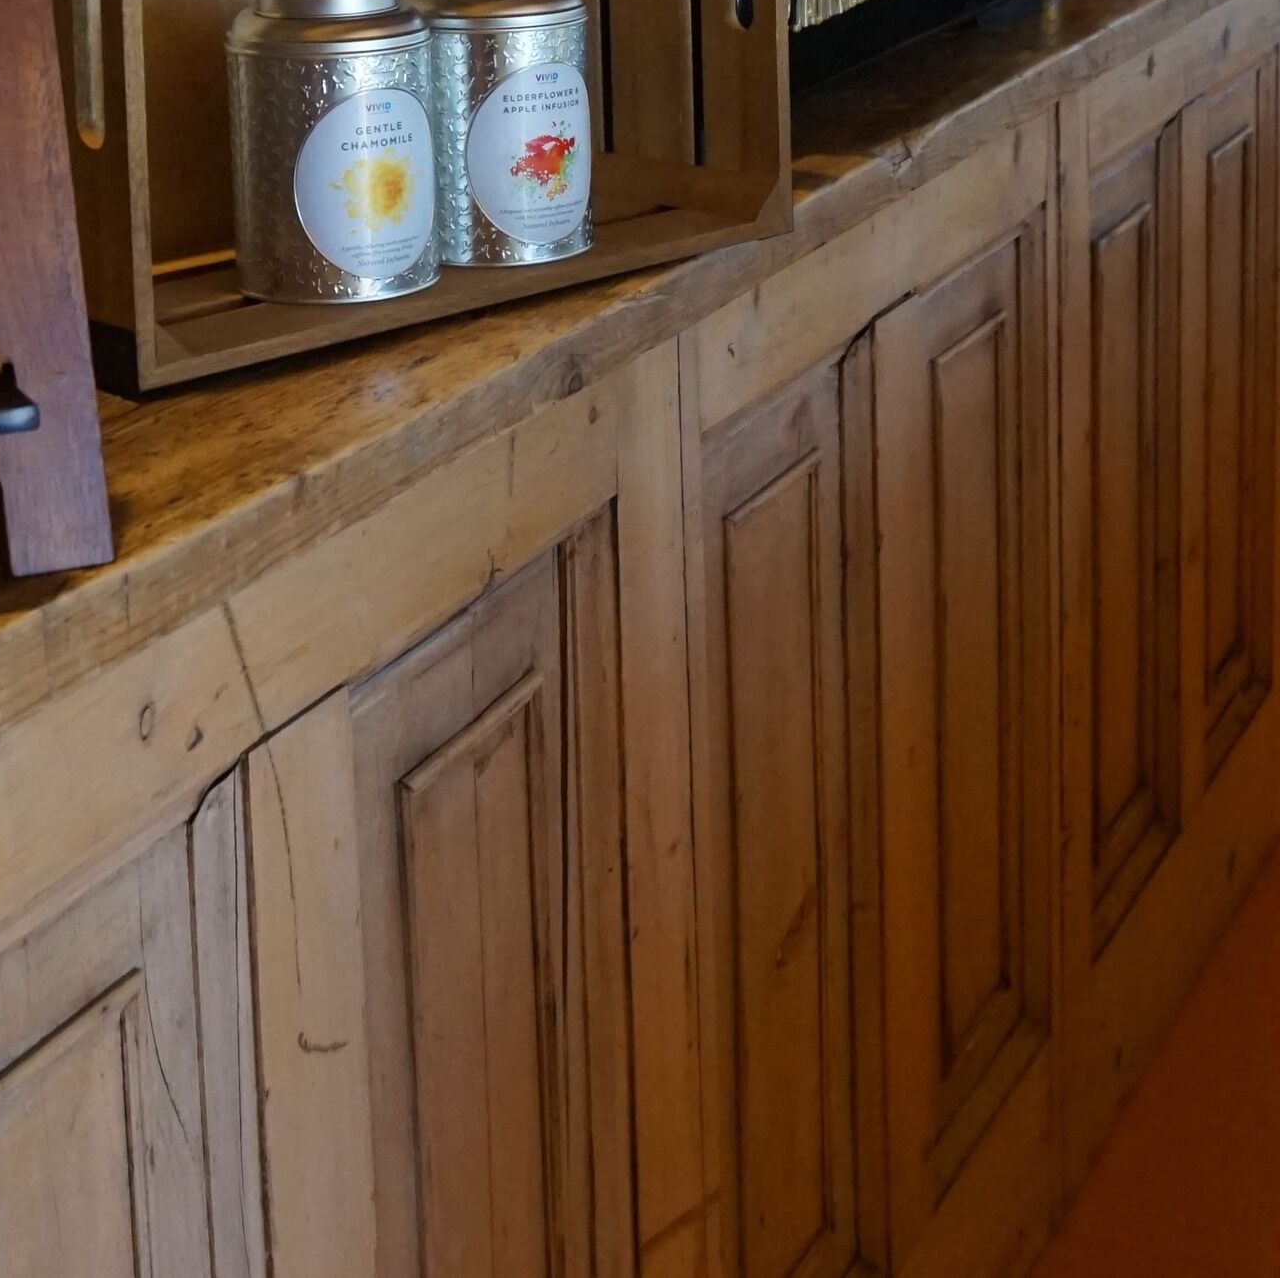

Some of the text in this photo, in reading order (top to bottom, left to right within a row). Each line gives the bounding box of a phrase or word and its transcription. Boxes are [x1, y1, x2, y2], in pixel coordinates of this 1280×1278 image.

[502, 88, 573, 103] ELDERFLOWER
[503, 98, 579, 114] APPLE INFUSION
[355, 121, 403, 136] GENTLE
[341, 132, 413, 152] CHAMOMILE
